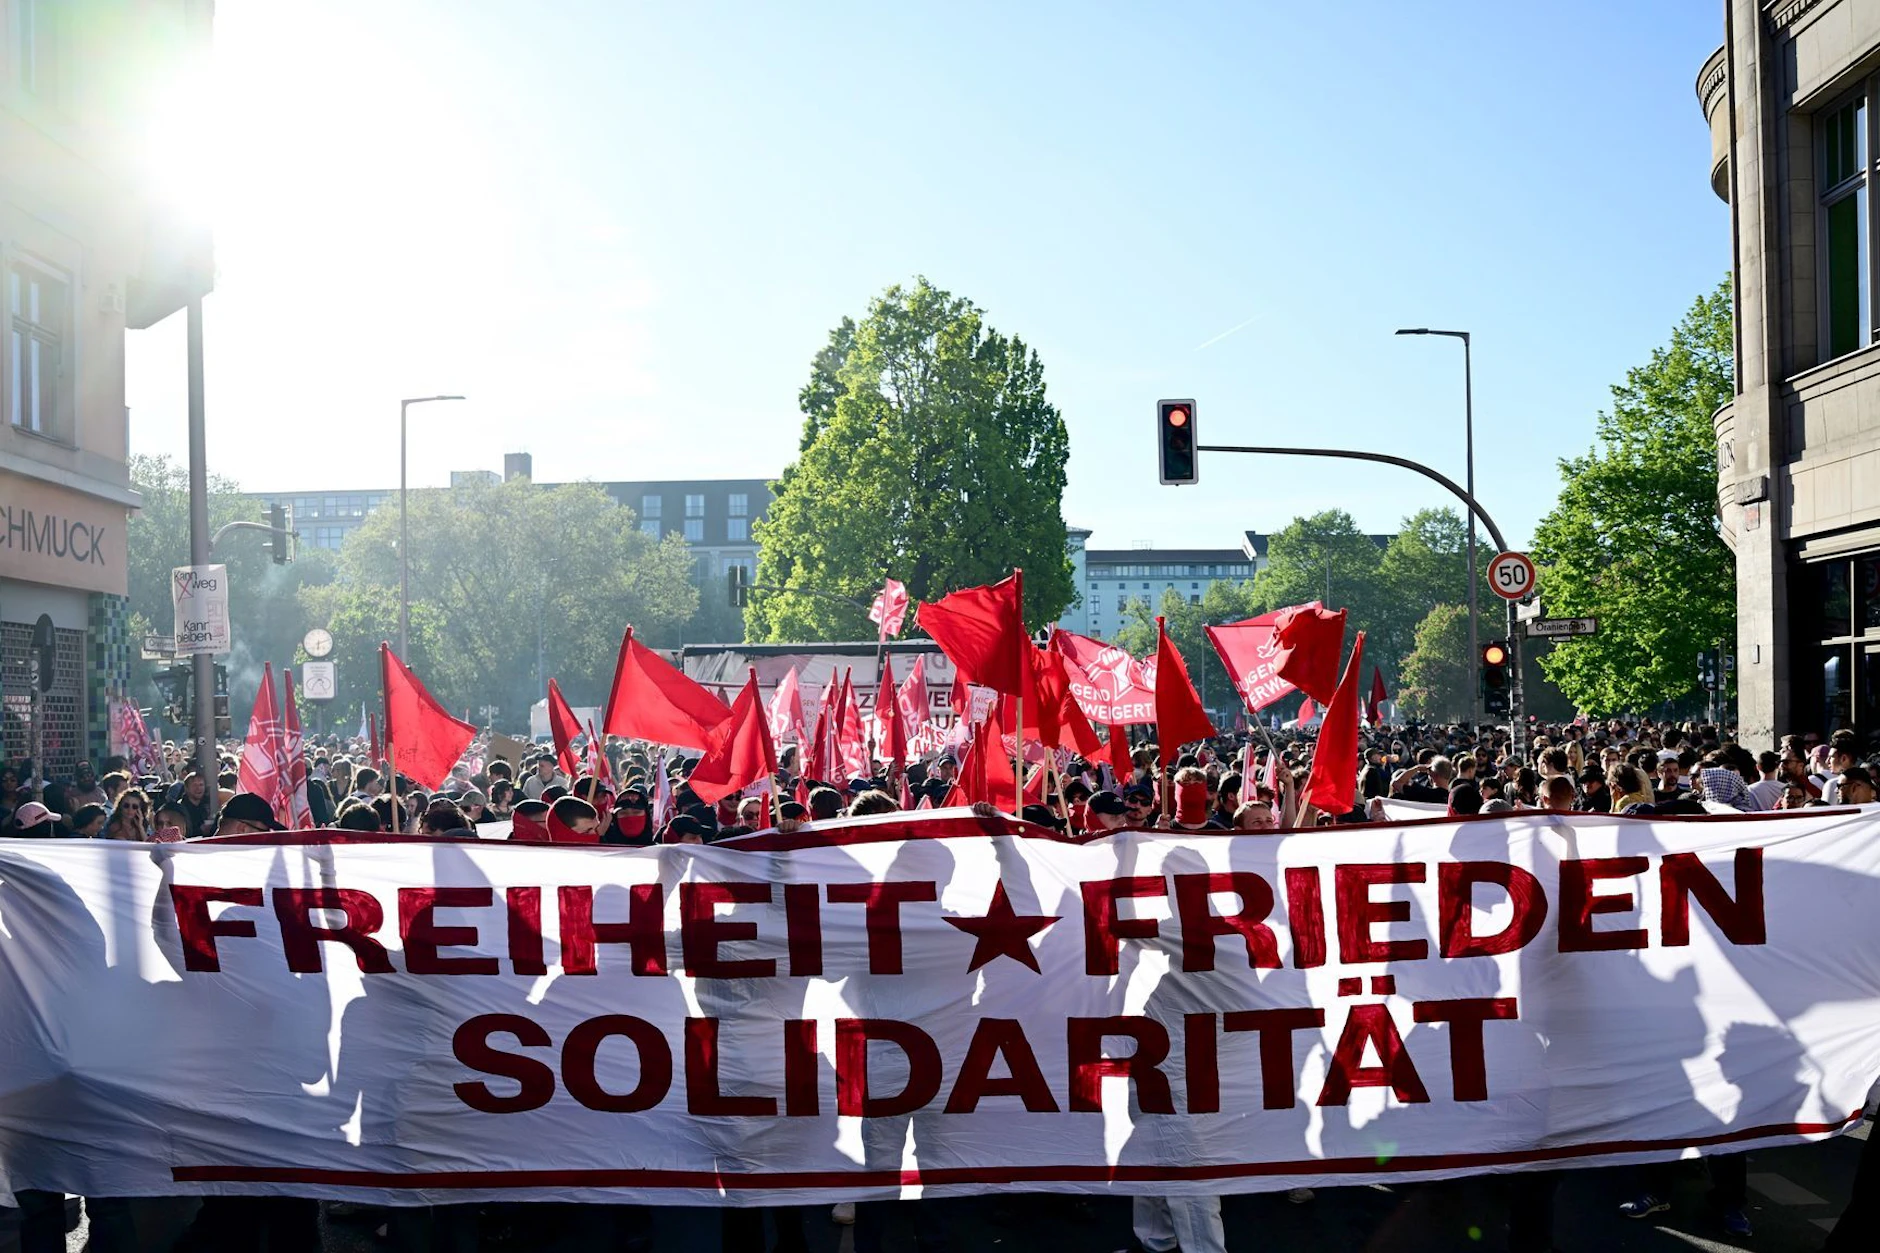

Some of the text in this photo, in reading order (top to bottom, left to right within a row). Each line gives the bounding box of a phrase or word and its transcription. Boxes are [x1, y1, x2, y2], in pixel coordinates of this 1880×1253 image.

[0, 506, 105, 566] HMUCK
[192, 579, 217, 591] weg
[1500, 565, 1526, 586] 50
[1069, 682, 1111, 701] GEND
[170, 847, 1768, 979] FREIHEIT FRIEDEN
[451, 975, 1519, 1119] SOLIDARITÄT
